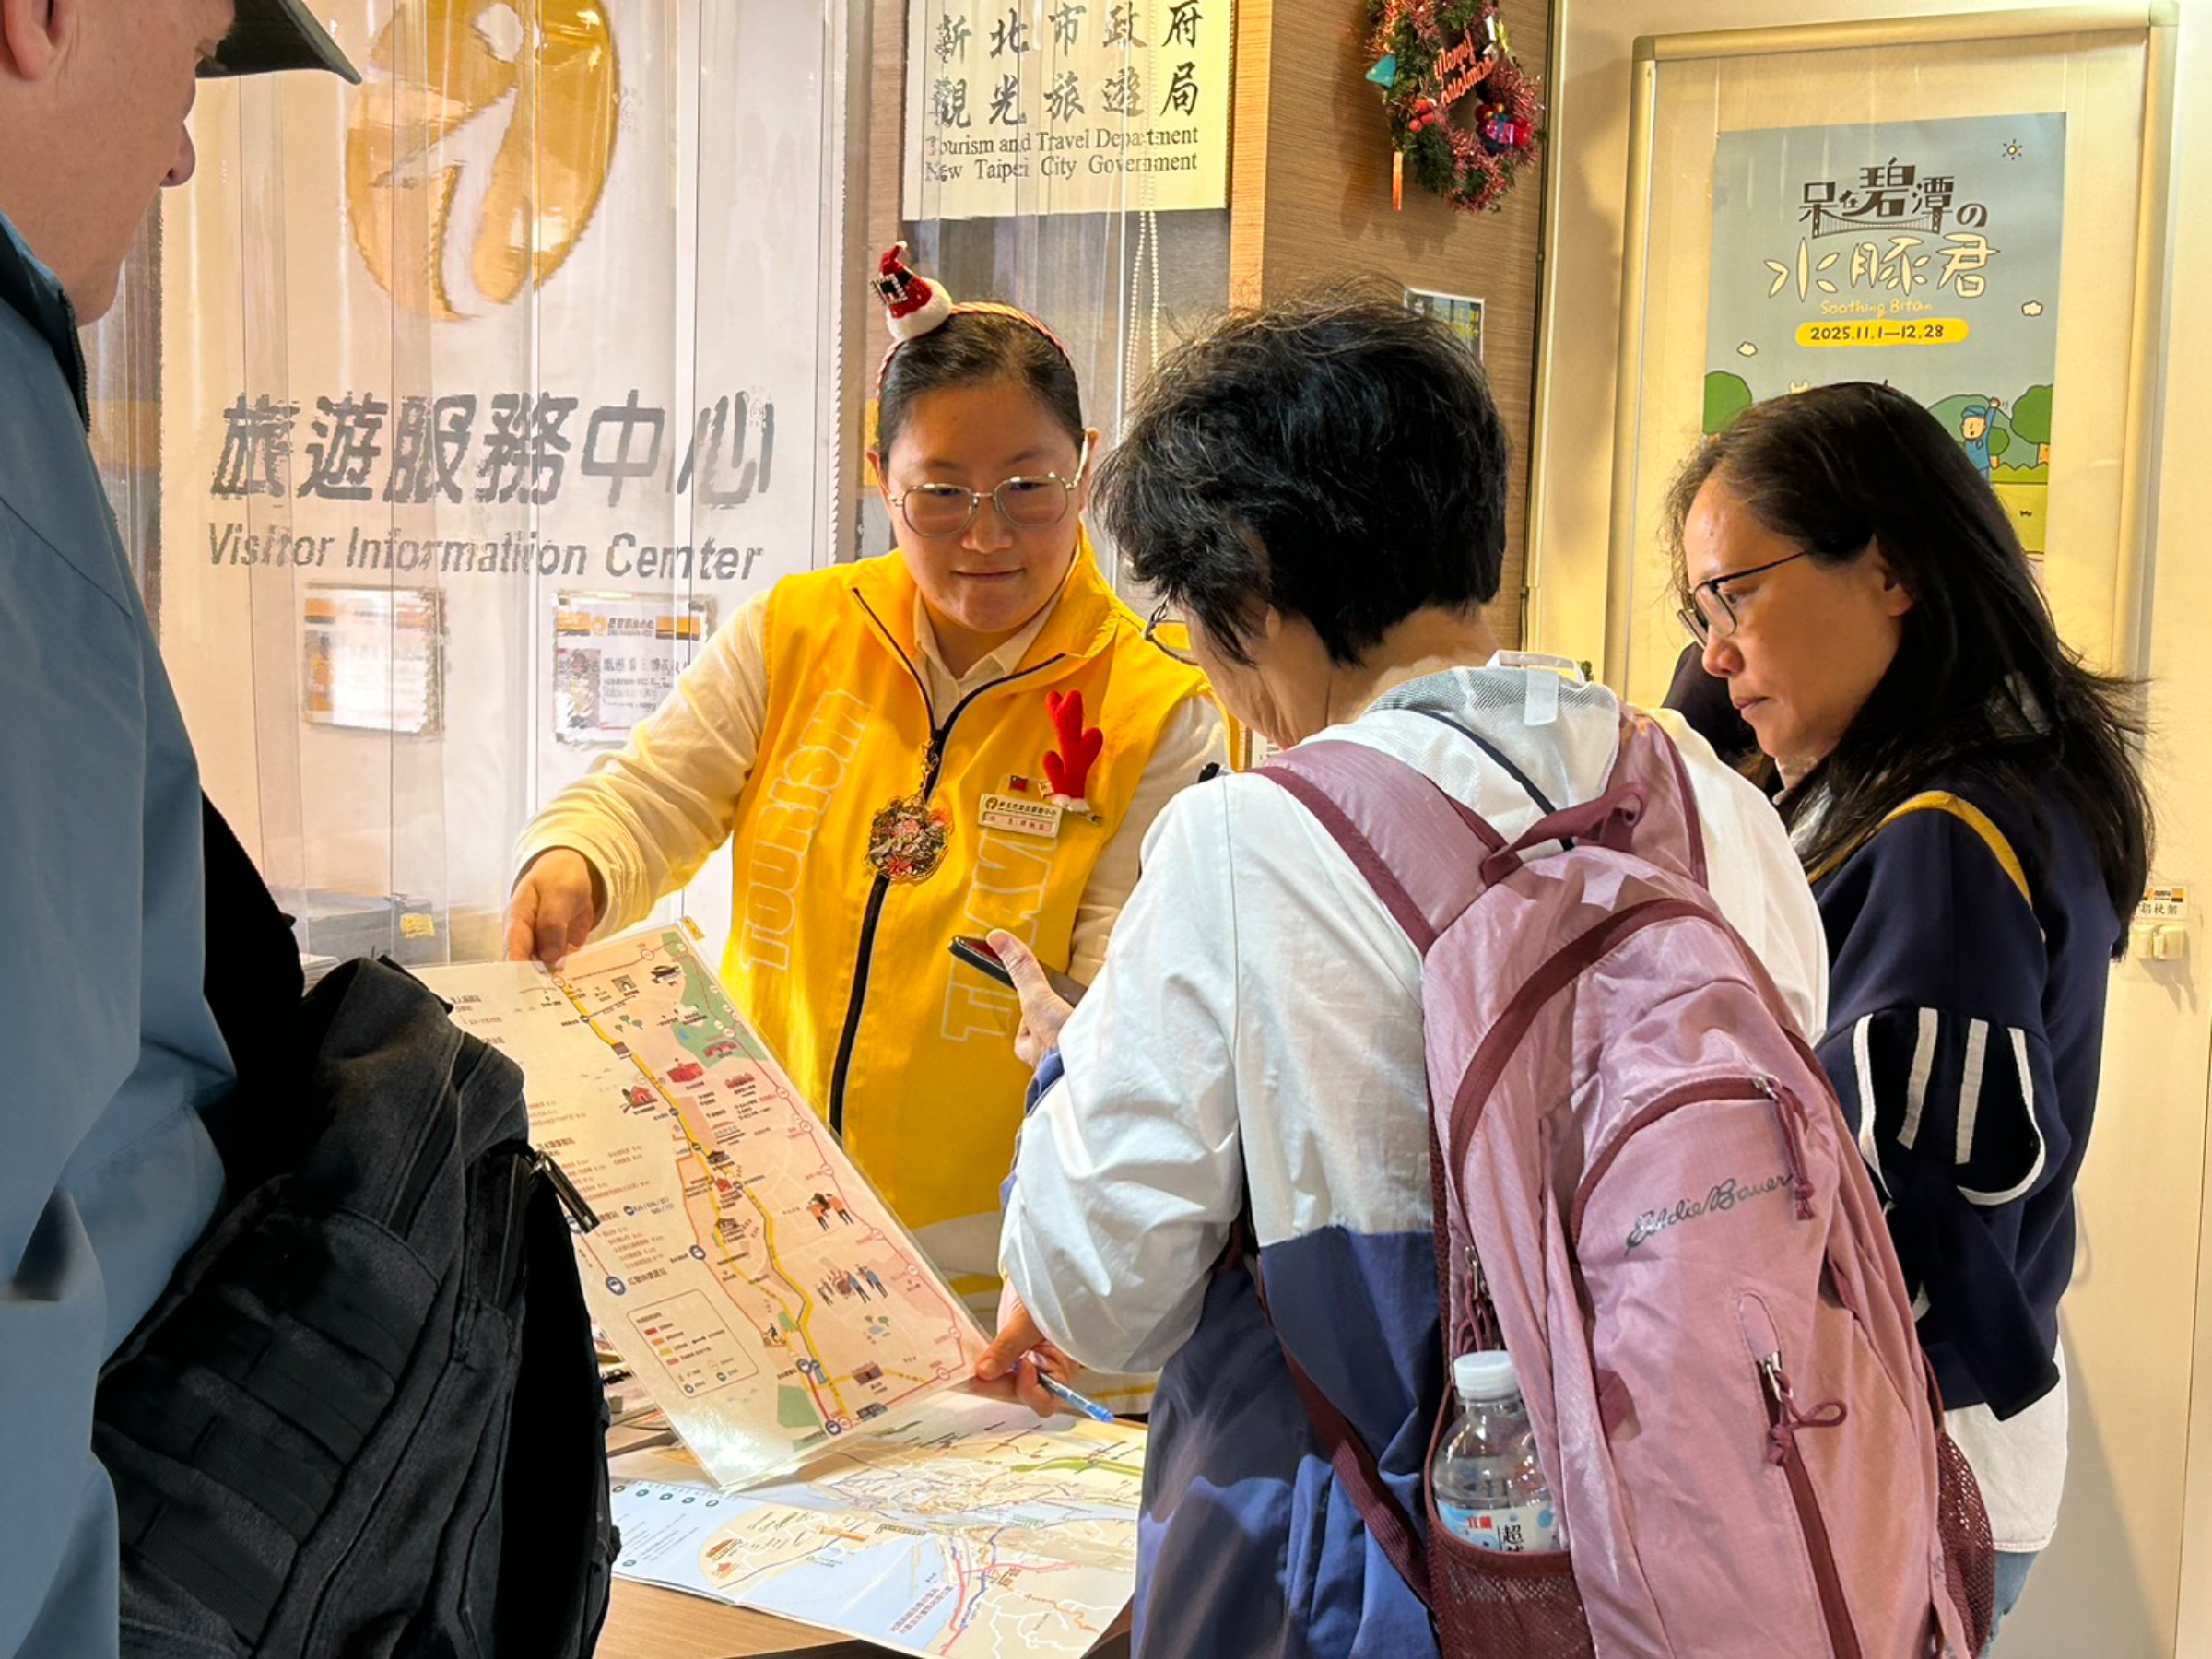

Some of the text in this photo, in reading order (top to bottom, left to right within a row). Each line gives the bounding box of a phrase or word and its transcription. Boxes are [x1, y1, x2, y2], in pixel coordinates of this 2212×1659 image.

[934, 1, 1203, 64] 新北市政府
[933, 62, 1200, 129] 觀光旅遊局
[924, 152, 1198, 183] New Taipei City Government
[999, 132, 1032, 154] and
[1036, 128, 1089, 153] Travel
[1763, 231, 2001, 303] 水豚君
[1820, 298, 1934, 320] Soothing Bitan
[209, 389, 777, 509] 旅遊服務中心
[207, 522, 764, 581] Visitor Information Center
[739, 689, 873, 972] TOURISM
[1625, 1172, 1794, 1258] Eddie Bauer
